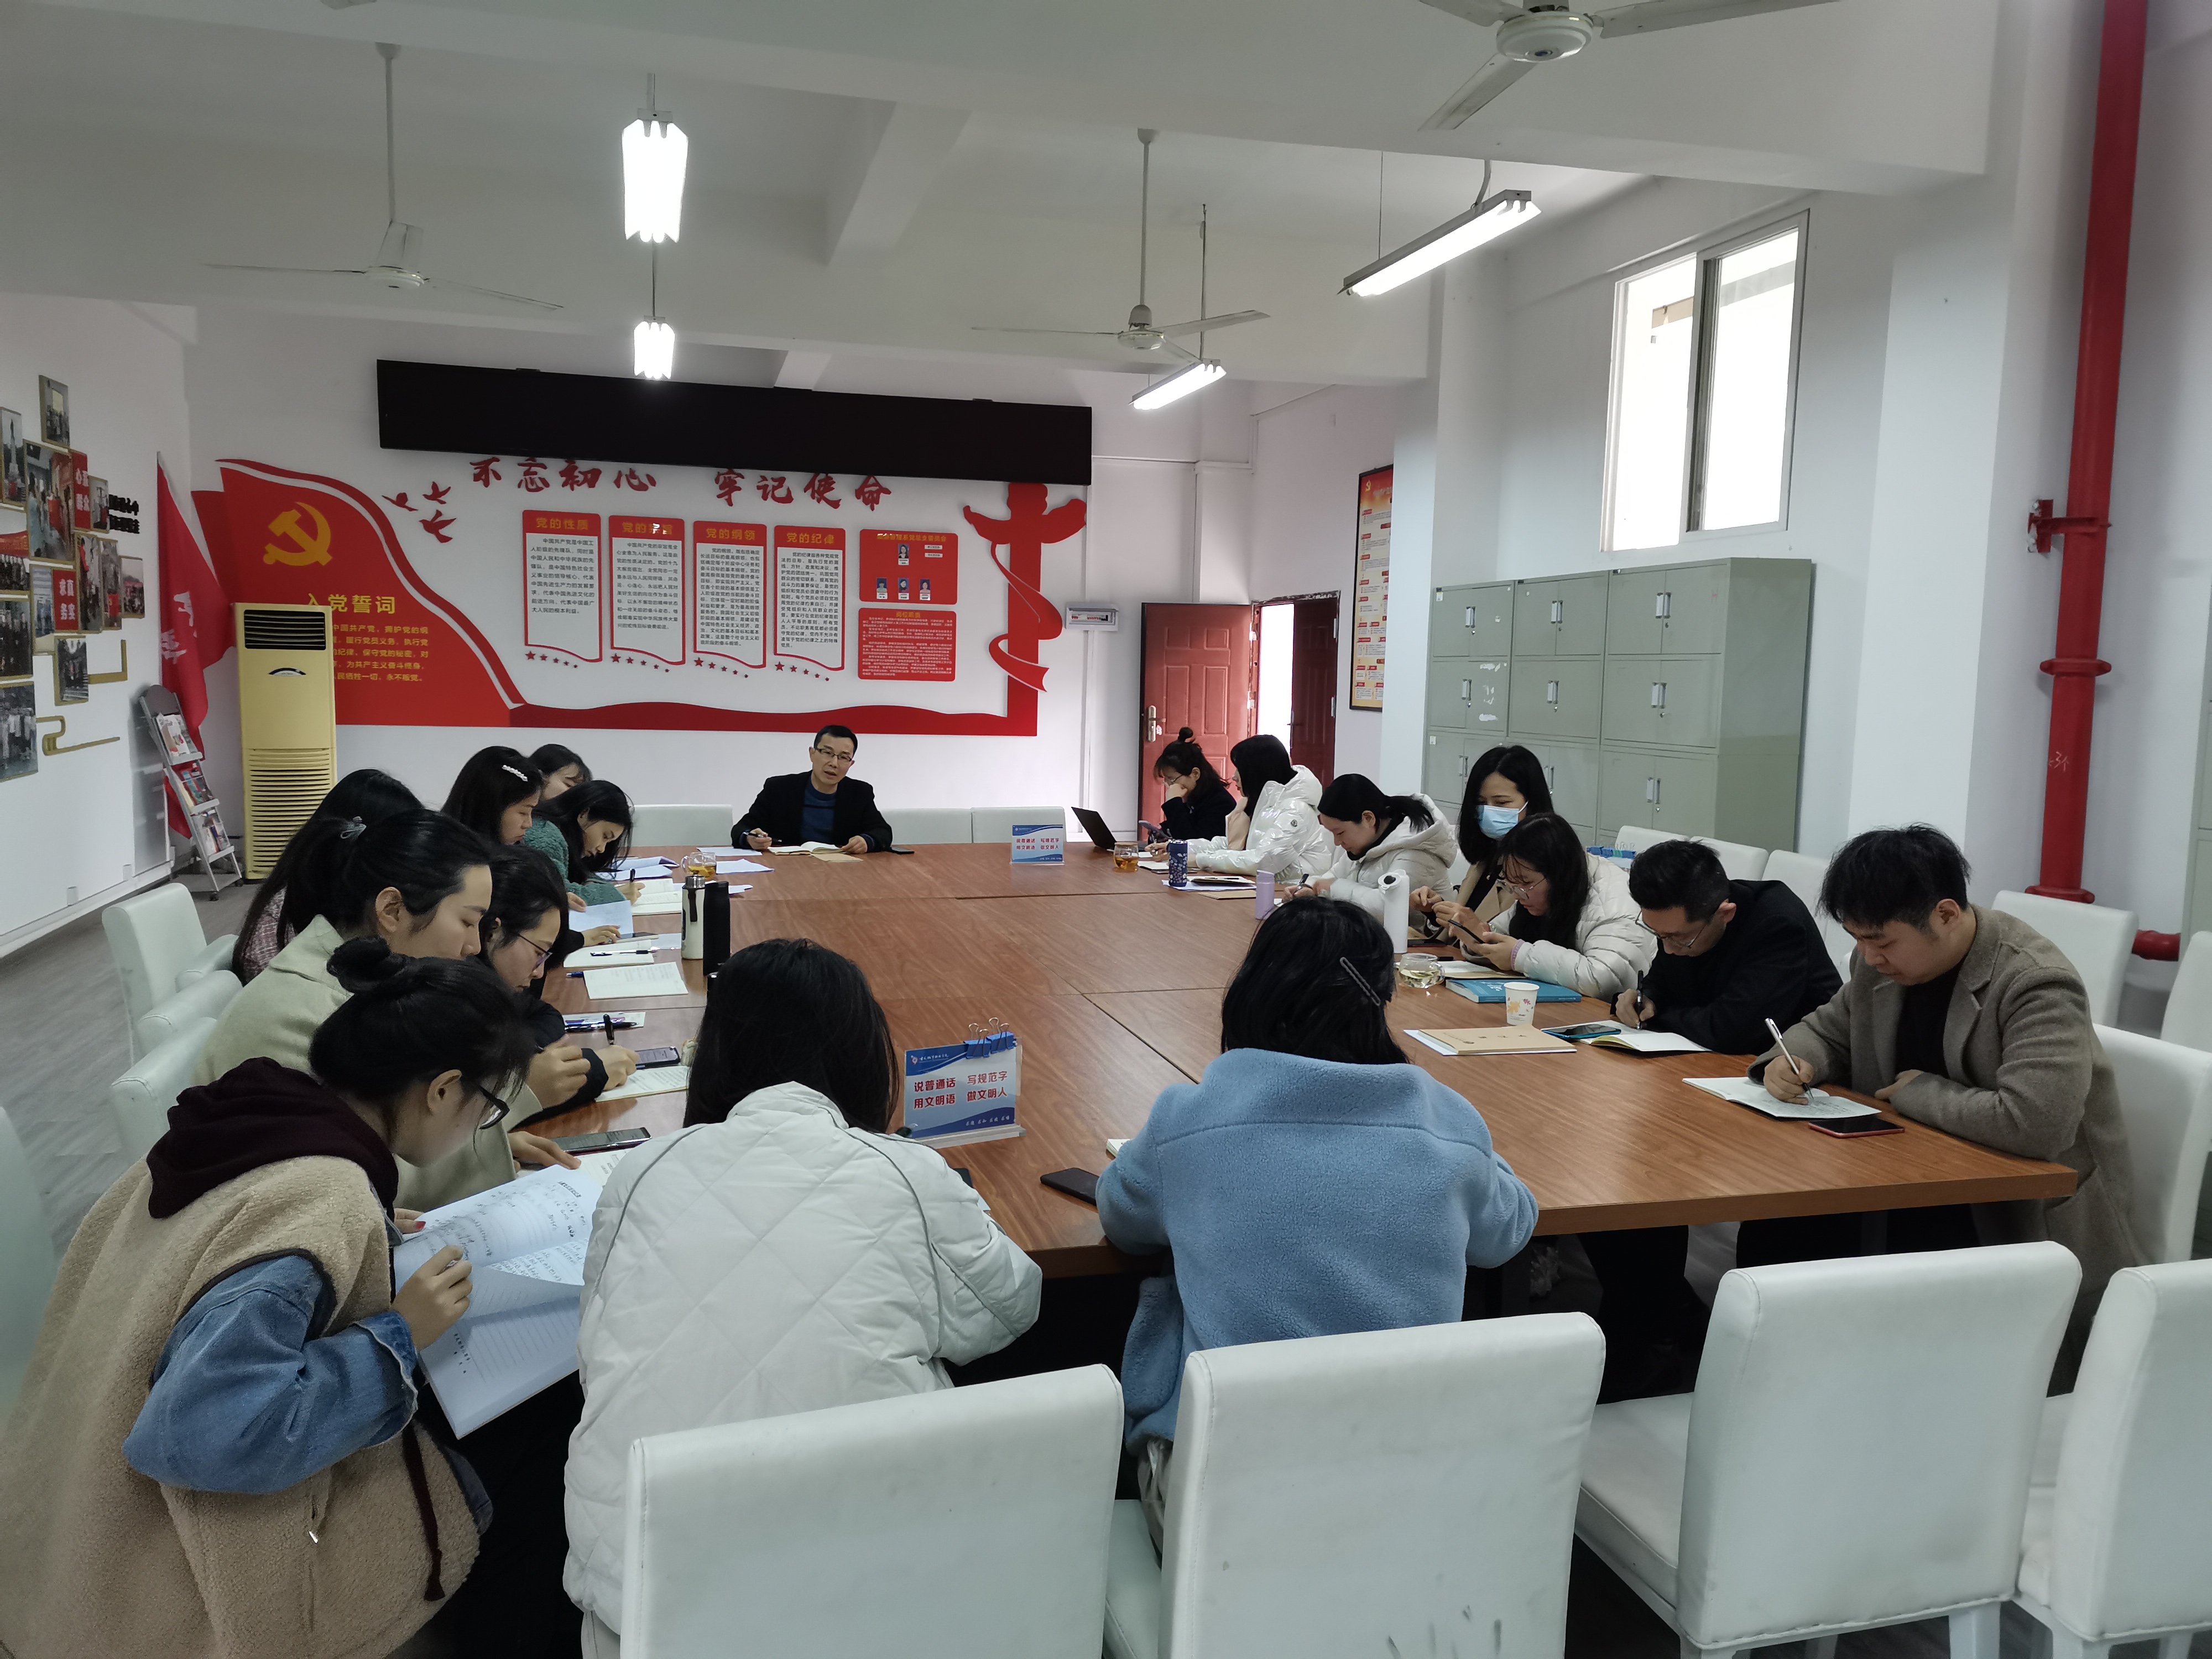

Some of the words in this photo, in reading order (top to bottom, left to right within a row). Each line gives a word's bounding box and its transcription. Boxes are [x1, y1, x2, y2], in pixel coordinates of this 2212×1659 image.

[470, 457, 656, 492] 不忘初心
[714, 469, 891, 511] 牢记使命
[536, 518, 588, 530] 党的性质
[706, 528, 755, 540] 党的纲领
[787, 533, 834, 544] 党的纪律
[309, 593, 396, 614] 入党誓词
[914, 1078, 956, 1092] 说普通话
[967, 1071, 1008, 1085] 写规范字
[914, 1094, 955, 1109] 用文明语
[967, 1087, 1007, 1102] 做文明人
